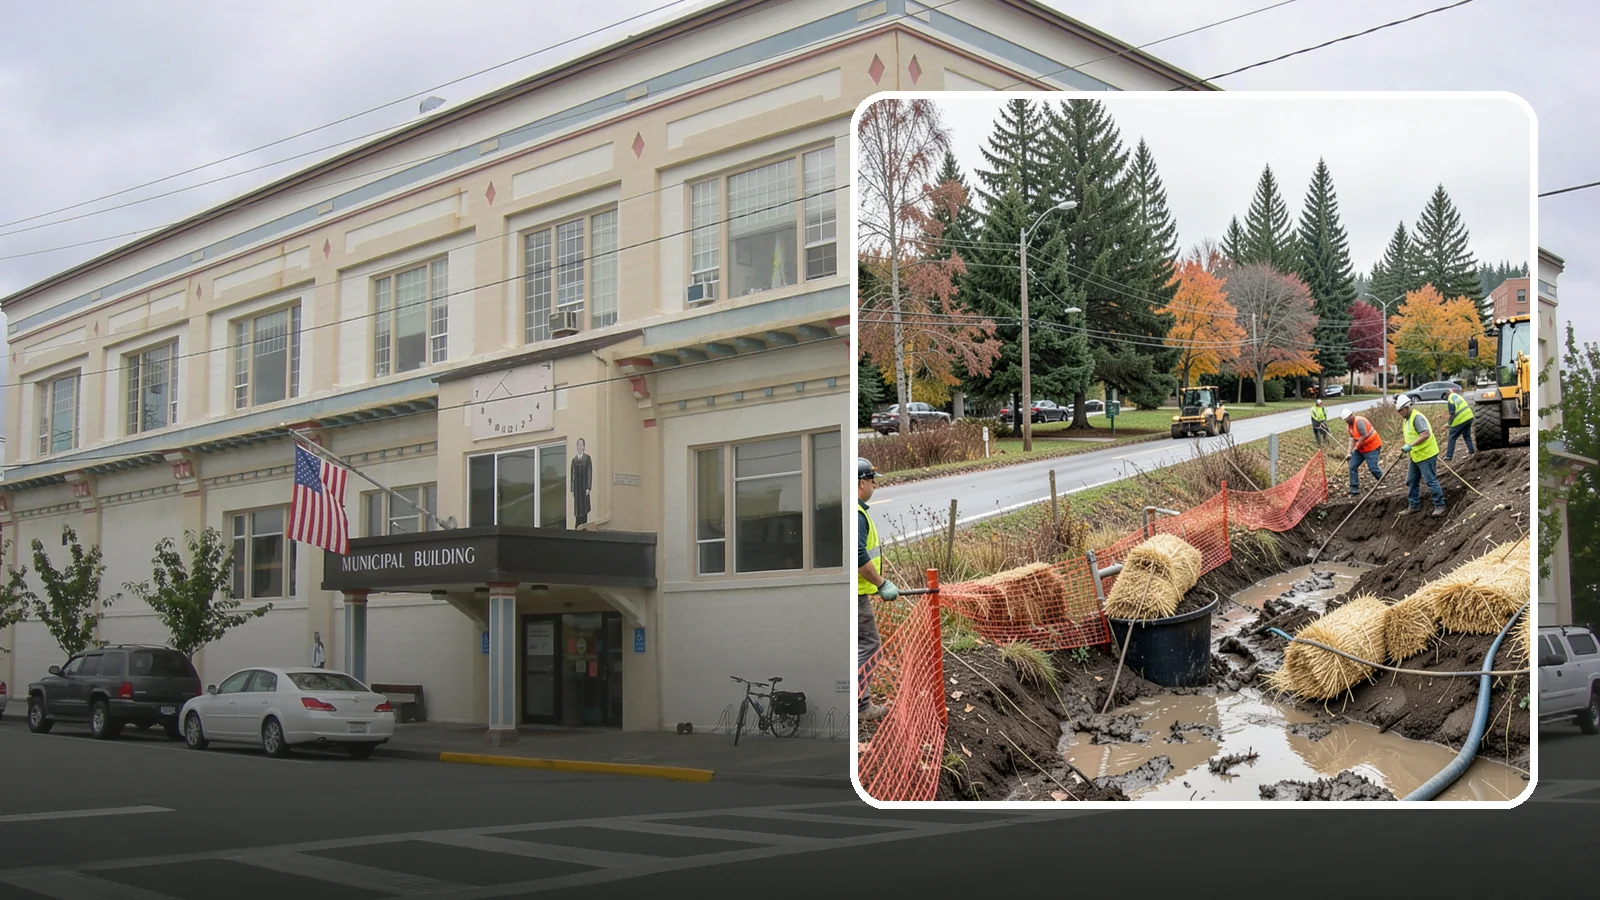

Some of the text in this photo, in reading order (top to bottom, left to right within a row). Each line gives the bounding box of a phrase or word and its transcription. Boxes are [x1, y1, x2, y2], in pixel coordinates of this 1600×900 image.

[547, 362, 552, 370] 6
[480, 407, 485, 415] 8
[488, 418, 492, 426] 9
[342, 546, 475, 572] MUNICIPAL BUILDING
